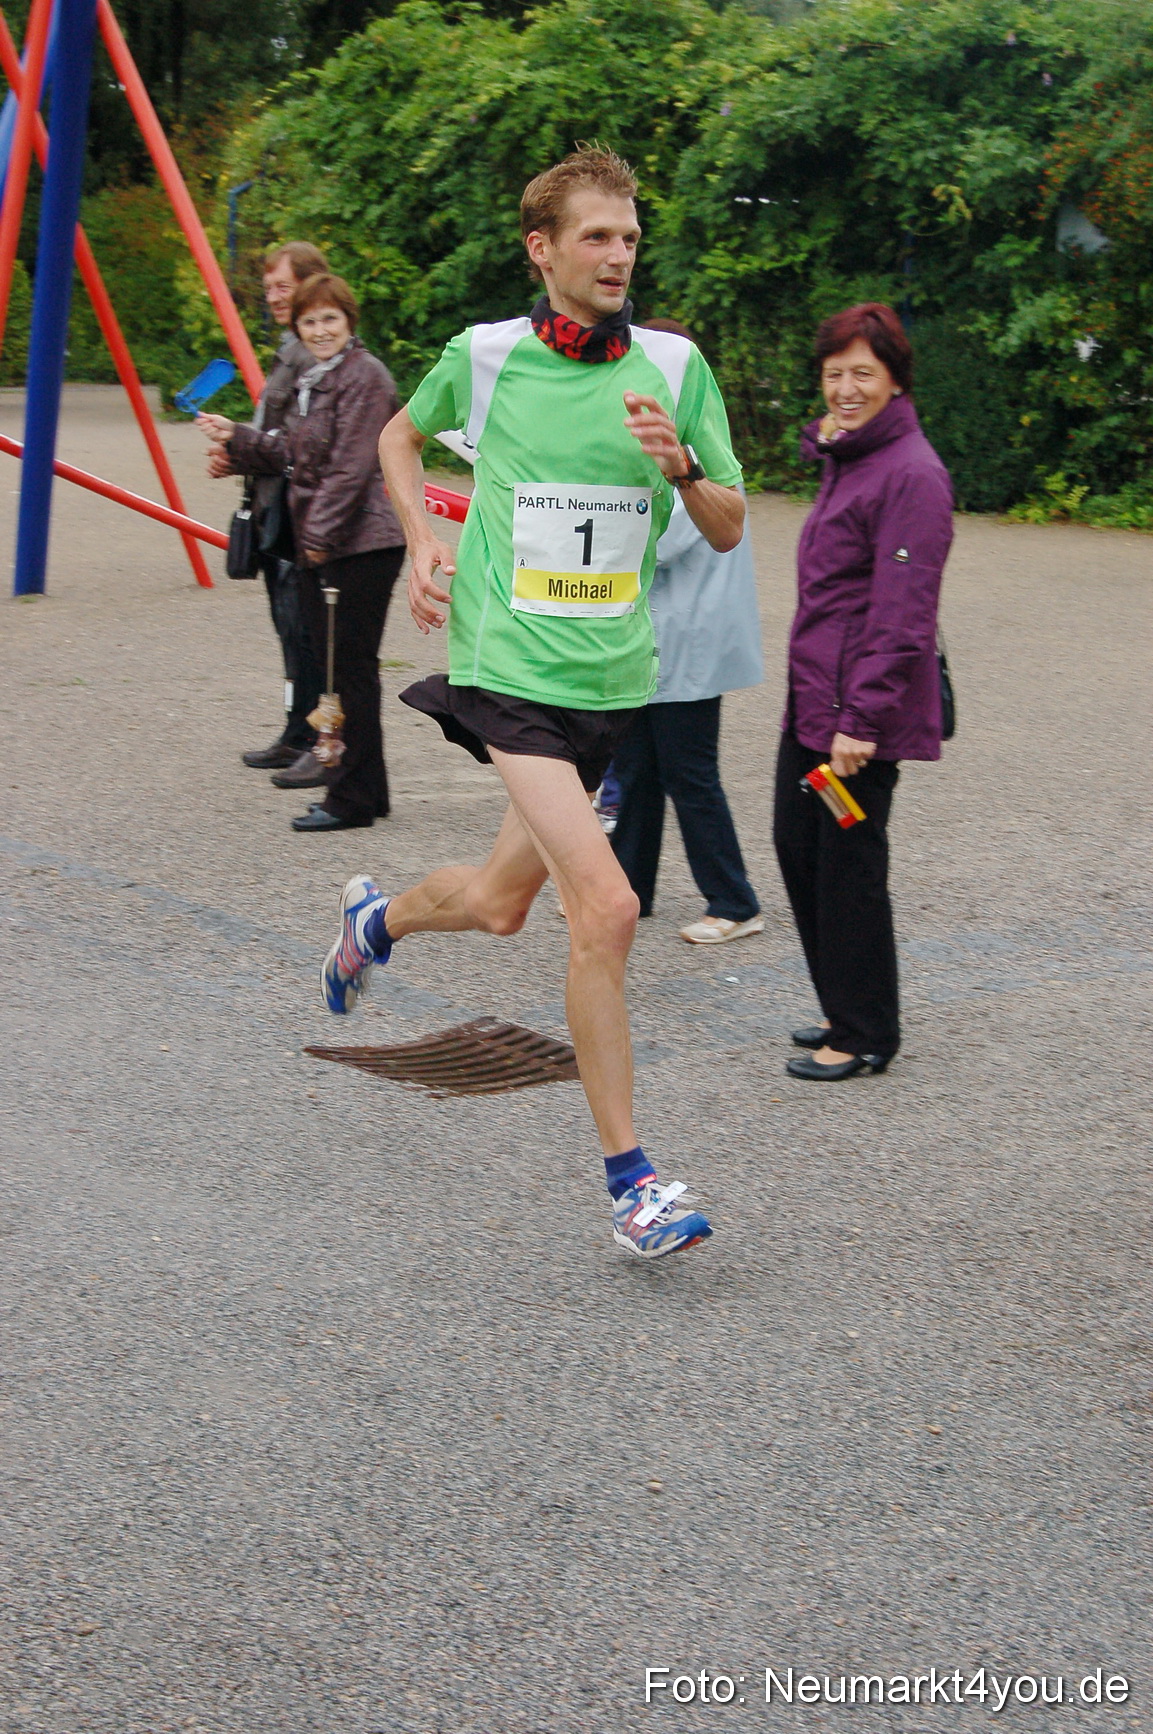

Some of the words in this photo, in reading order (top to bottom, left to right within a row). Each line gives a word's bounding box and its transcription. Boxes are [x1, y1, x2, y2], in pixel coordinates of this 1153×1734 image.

[518, 496, 564, 510] PARTL
[568, 498, 632, 513] Neumarkt
[574, 518, 594, 566] 1
[519, 558, 526, 568] A
[548, 578, 613, 599] Michael
